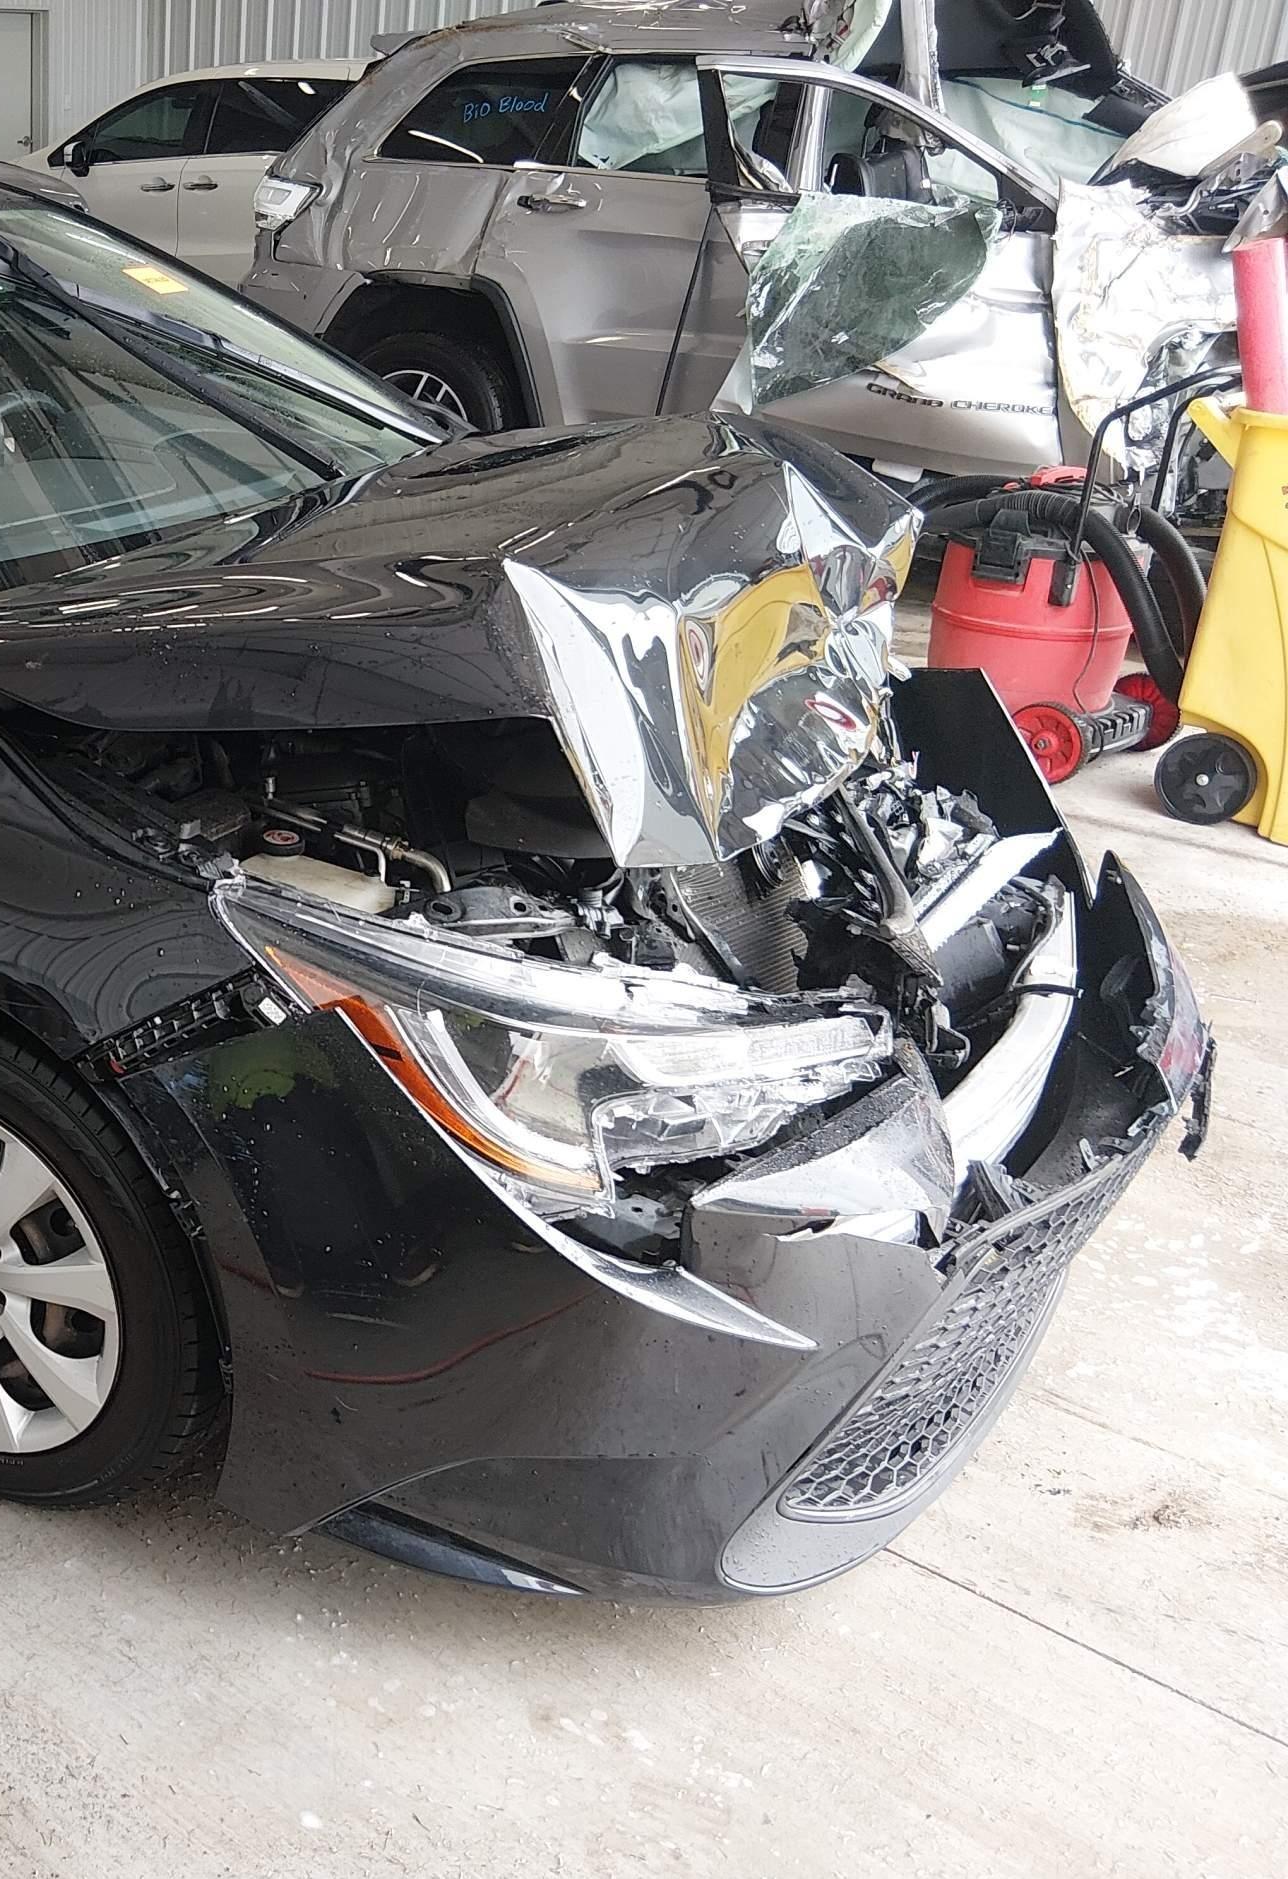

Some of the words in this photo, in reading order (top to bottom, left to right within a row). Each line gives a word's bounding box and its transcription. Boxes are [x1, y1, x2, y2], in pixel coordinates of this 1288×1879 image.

[499, 92, 550, 114] Blood
[866, 382, 944, 407] GRAND
[951, 399, 1056, 416] CHEROKE
